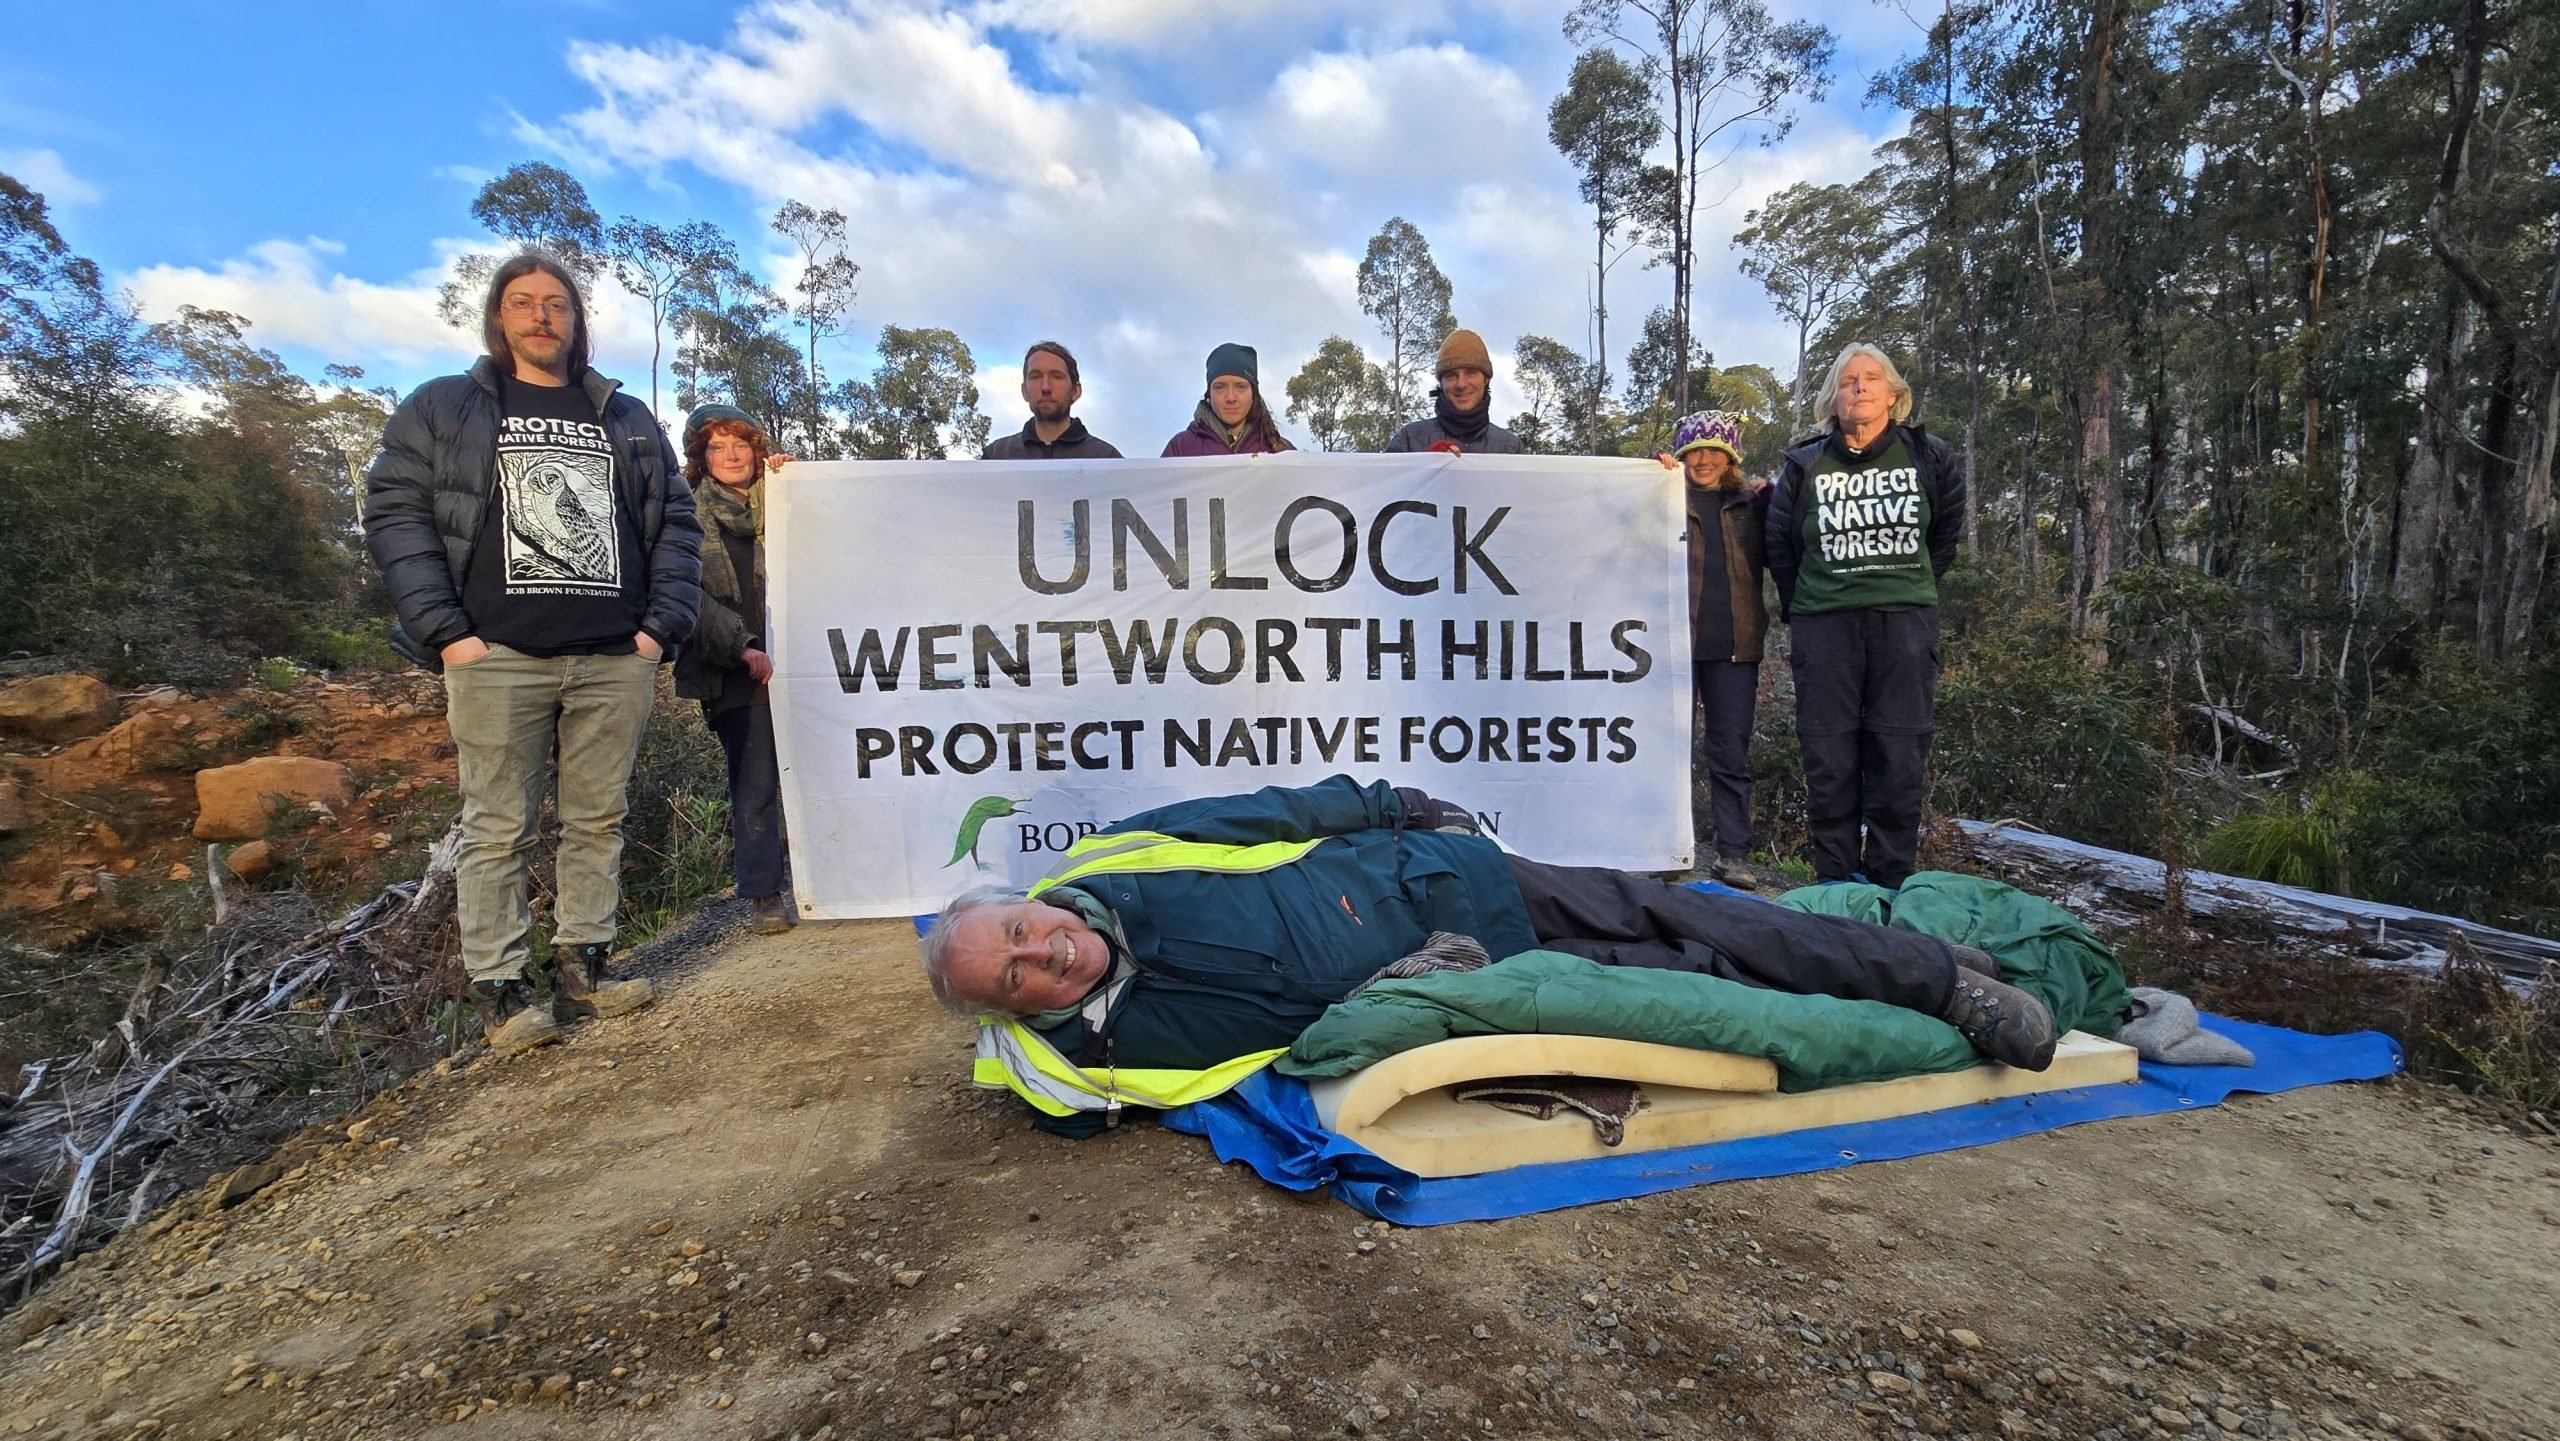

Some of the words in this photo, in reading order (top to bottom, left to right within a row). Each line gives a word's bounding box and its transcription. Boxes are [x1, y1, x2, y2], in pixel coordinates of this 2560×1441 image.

[549, 434, 612, 452] FORESTS
[1815, 468, 1919, 503] PROTECT
[1818, 495, 1921, 533] NATIVE
[1018, 496, 1520, 596] UNLOCK
[1820, 526, 1921, 562] FORESTS
[505, 587, 525, 595] BOB
[527, 587, 562, 595] BROWN
[565, 587, 620, 598] FOUNDATION
[827, 617, 1417, 693] WENTWORTH
[1441, 619, 1652, 684] HILLS
[856, 720, 1144, 778] PROTECT
[1164, 717, 1380, 767] NATIVE
[1400, 716, 1637, 763] FORESTS
